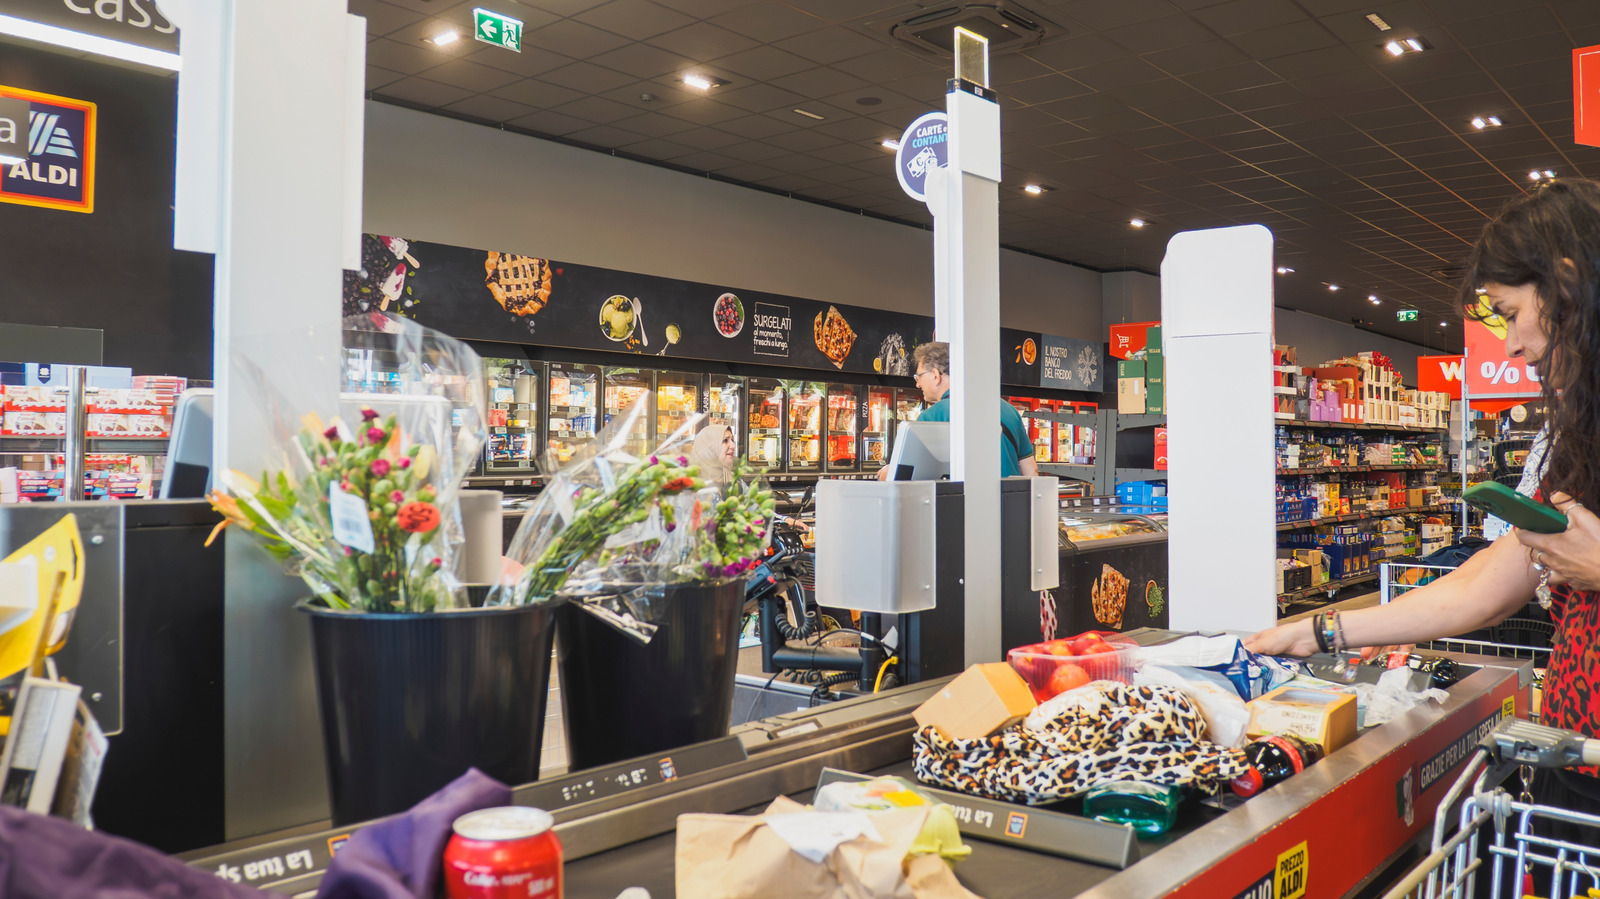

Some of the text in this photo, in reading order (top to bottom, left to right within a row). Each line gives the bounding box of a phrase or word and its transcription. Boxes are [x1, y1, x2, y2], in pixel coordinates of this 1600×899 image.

[916, 124, 943, 138] CARTE
[8, 161, 78, 188] ALDI
[753, 314, 792, 330] SURGELATI
[1044, 345, 1068, 359] IL NOSTRO
[1044, 356, 1061, 368] BANCO
[1044, 367, 1073, 380] DEL FREDDO
[1480, 361, 1520, 385] %
[1421, 753, 1445, 788] GRAZIE
[1446, 744, 1458, 770] PER
[1458, 738, 1467, 760] LA
[974, 809, 994, 829] La
[243, 856, 285, 880] tua
[285, 849, 314, 870] La
[1280, 849, 1304, 877] PREZZO
[1279, 866, 1303, 899] ALDI
